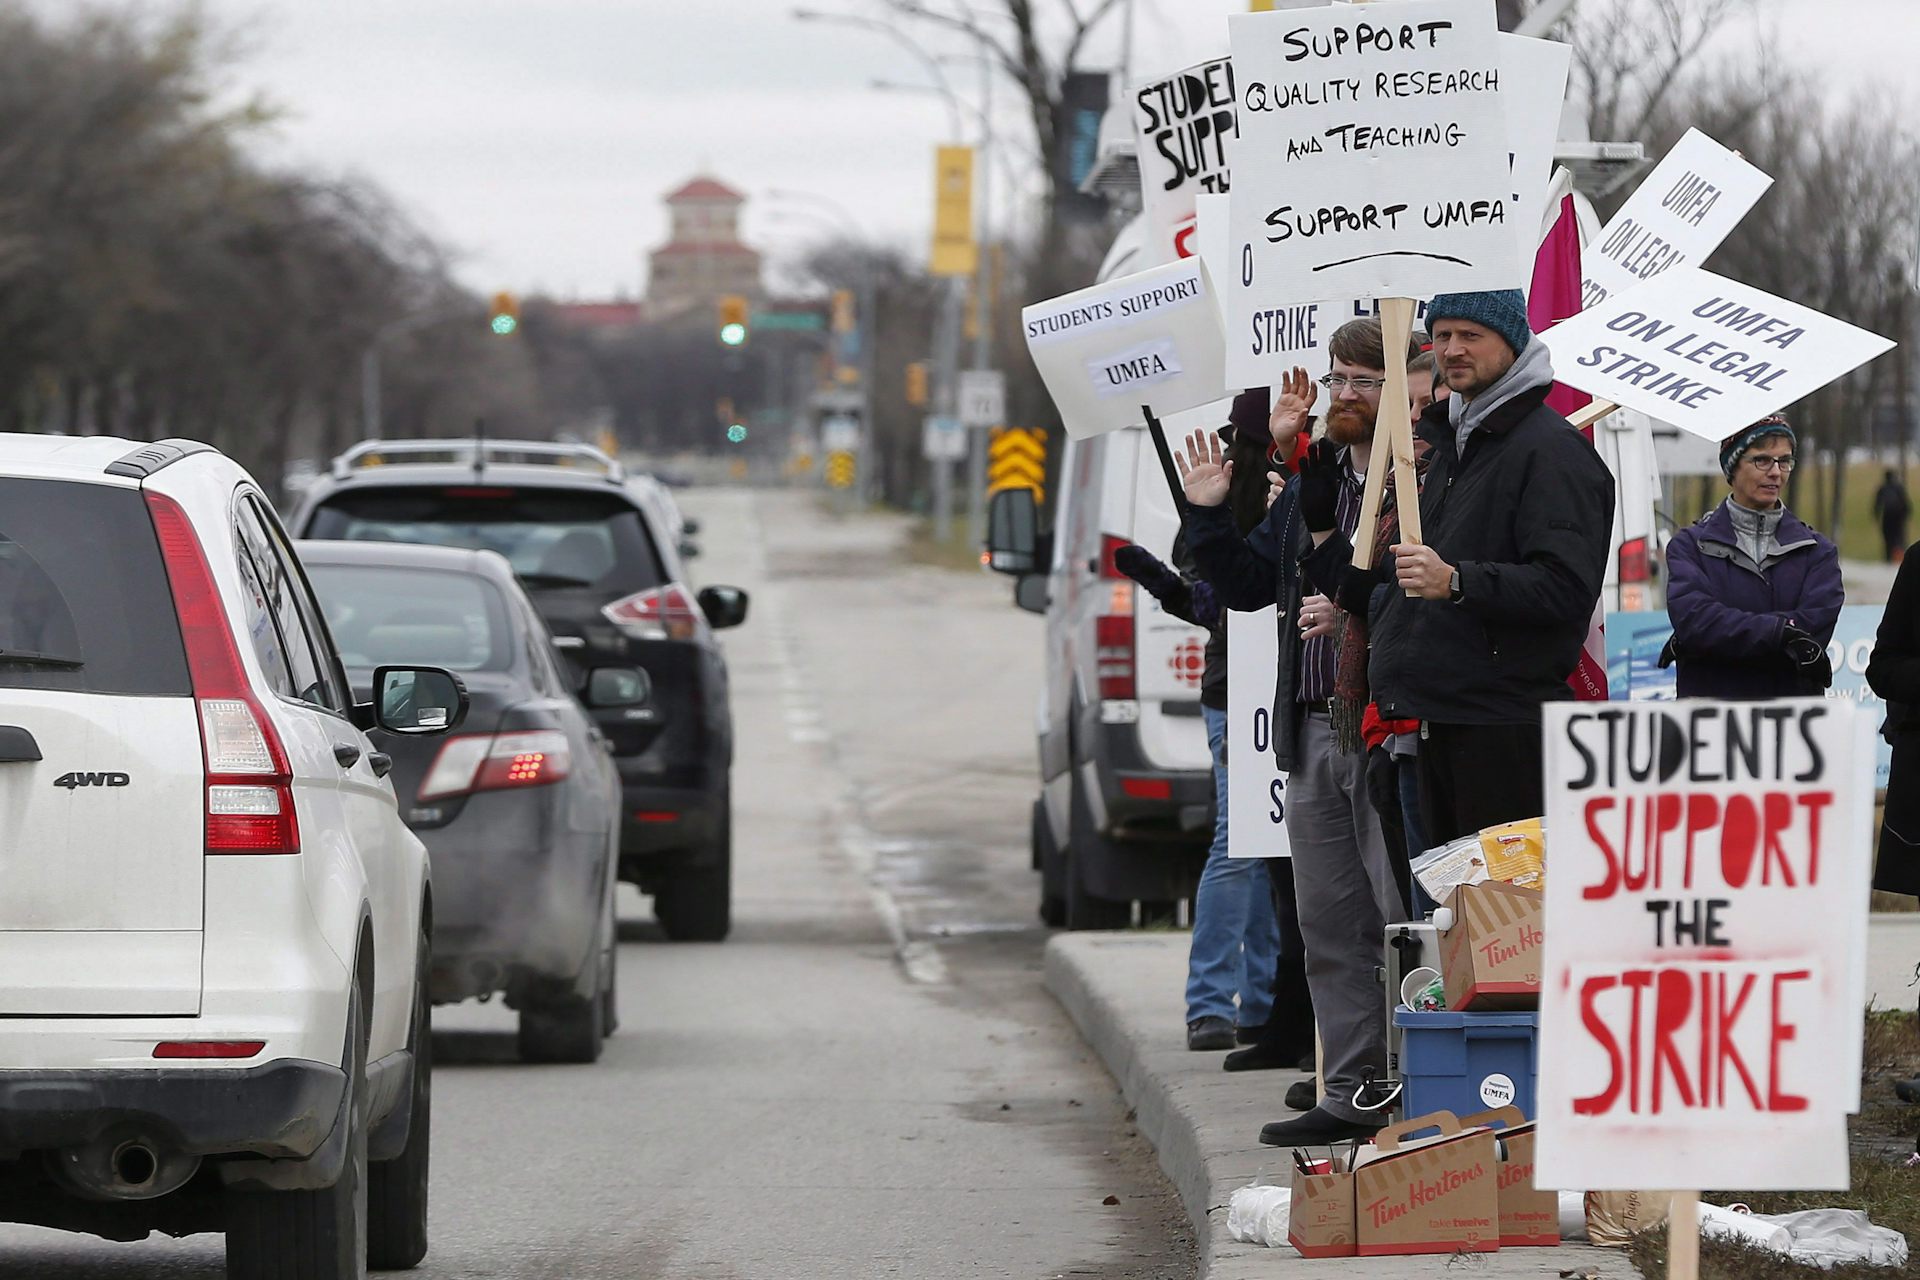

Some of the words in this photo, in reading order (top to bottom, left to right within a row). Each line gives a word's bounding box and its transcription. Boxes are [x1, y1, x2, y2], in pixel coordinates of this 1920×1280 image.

[1283, 21, 1452, 61] SUPPORT
[1137, 62, 1237, 134] STUDE
[1246, 79, 1361, 112] QUALITY
[1375, 69, 1499, 98] RESEARCH
[1156, 109, 1240, 191] SUPP
[1287, 136, 1323, 162] AND
[1324, 122, 1466, 152] TEACHING
[1661, 170, 1722, 227] UMFA
[1265, 204, 1408, 243] SUPPORT
[1423, 200, 1504, 228] UMFA
[1601, 218, 1643, 261] ON
[1028, 301, 1113, 337] STUDENTS
[1120, 277, 1199, 317] SUPPORT
[1252, 304, 1318, 355] STRIKE
[1692, 297, 1805, 349] UMFA
[1105, 354, 1167, 385] UMFA
[1606, 311, 1674, 342] ON
[1664, 333, 1788, 391] LEGAL
[1577, 346, 1723, 409] STRIKE
[1567, 707, 1828, 790] STUDENTS
[53, 772, 130, 789] 4WD
[1582, 792, 1833, 900] SUPPORT
[1646, 899, 1732, 947] THE
[1479, 938, 1519, 968] Tim
[1572, 969, 1811, 1116] STRIKE
[1484, 1088, 1509, 1100] UMFA
[1366, 1196, 1408, 1228] Tim
[1410, 1163, 1484, 1209] Hortons
[1513, 1211, 1550, 1222] twelve
[1452, 1217, 1490, 1228] twelve
[1467, 1232, 1479, 1241] 12
[1527, 1226, 1540, 1235] 12
